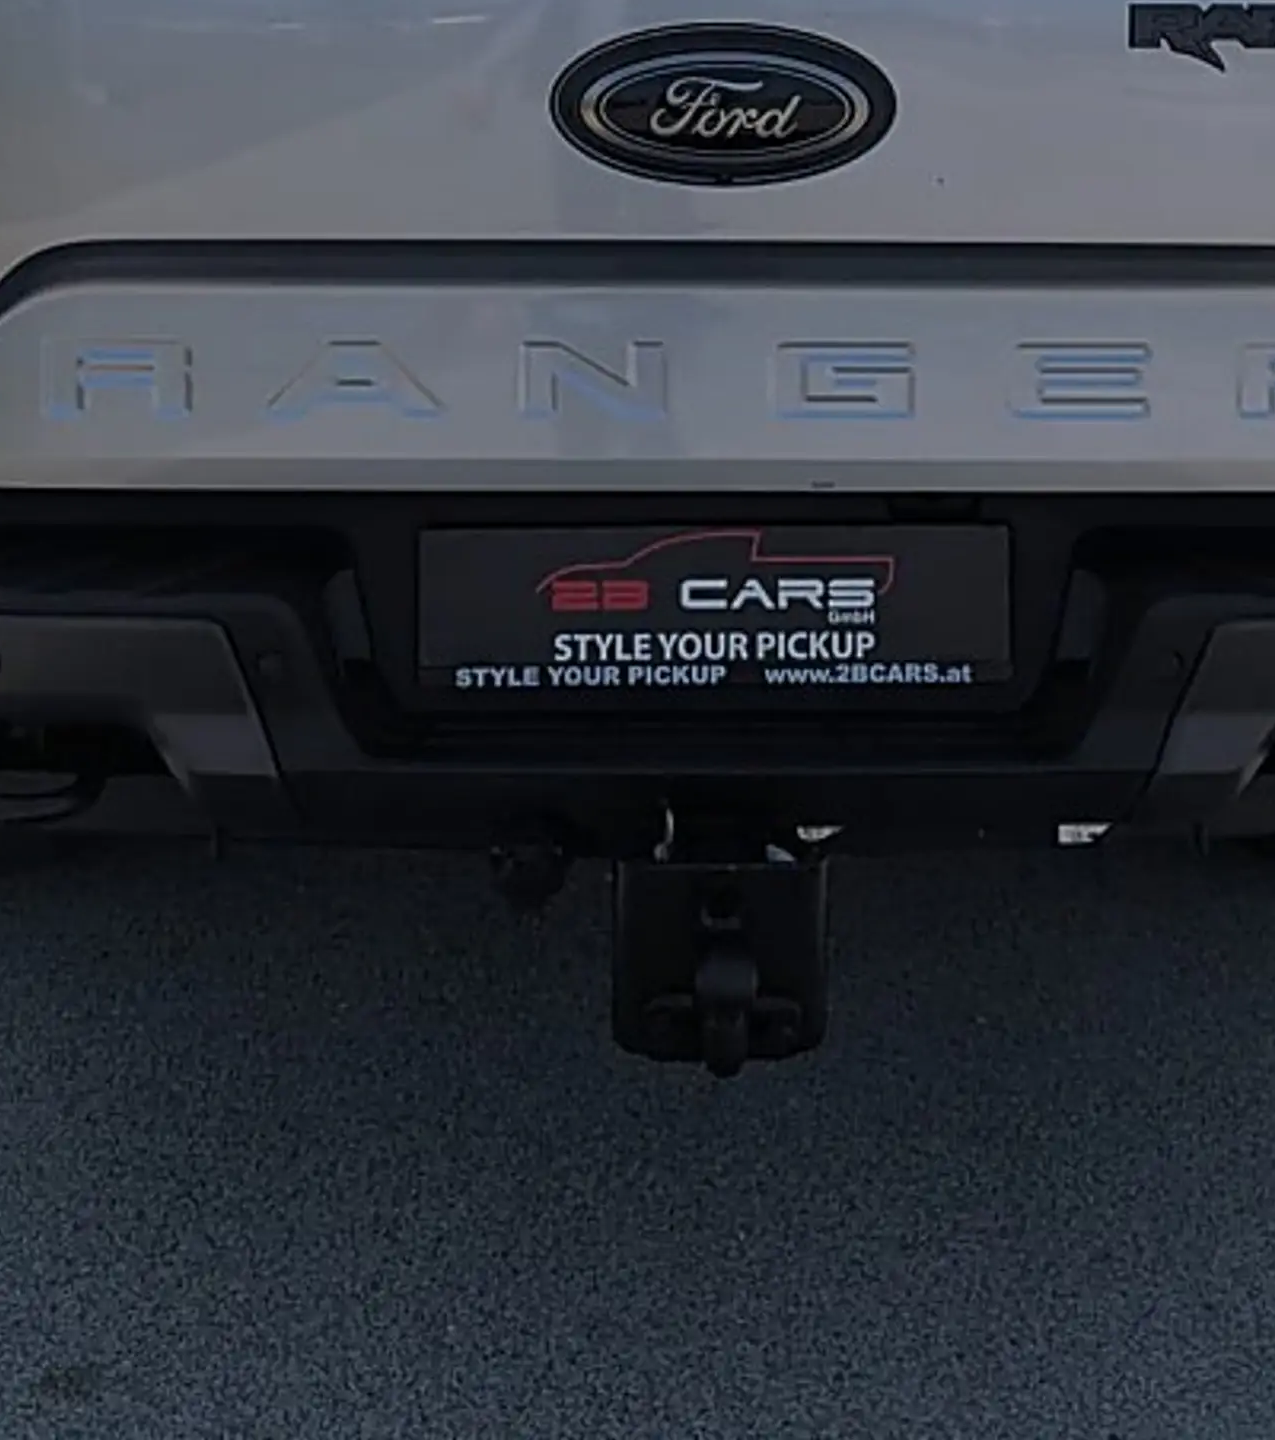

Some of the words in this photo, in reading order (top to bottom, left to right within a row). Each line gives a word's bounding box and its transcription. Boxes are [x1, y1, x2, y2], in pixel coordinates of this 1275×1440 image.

[649, 76, 802, 139] Ford
[551, 579, 649, 611] 2B
[681, 578, 875, 610] CARS
[828, 611, 875, 625] GmbH
[554, 632, 652, 661] STYLE
[658, 631, 748, 661] YOUR
[757, 631, 875, 660] PICKUP
[455, 666, 541, 688] STYLE
[548, 665, 621, 687] YOUR
[628, 664, 727, 686] PICKUP
[764, 662, 975, 685] www.2BCARS.at
